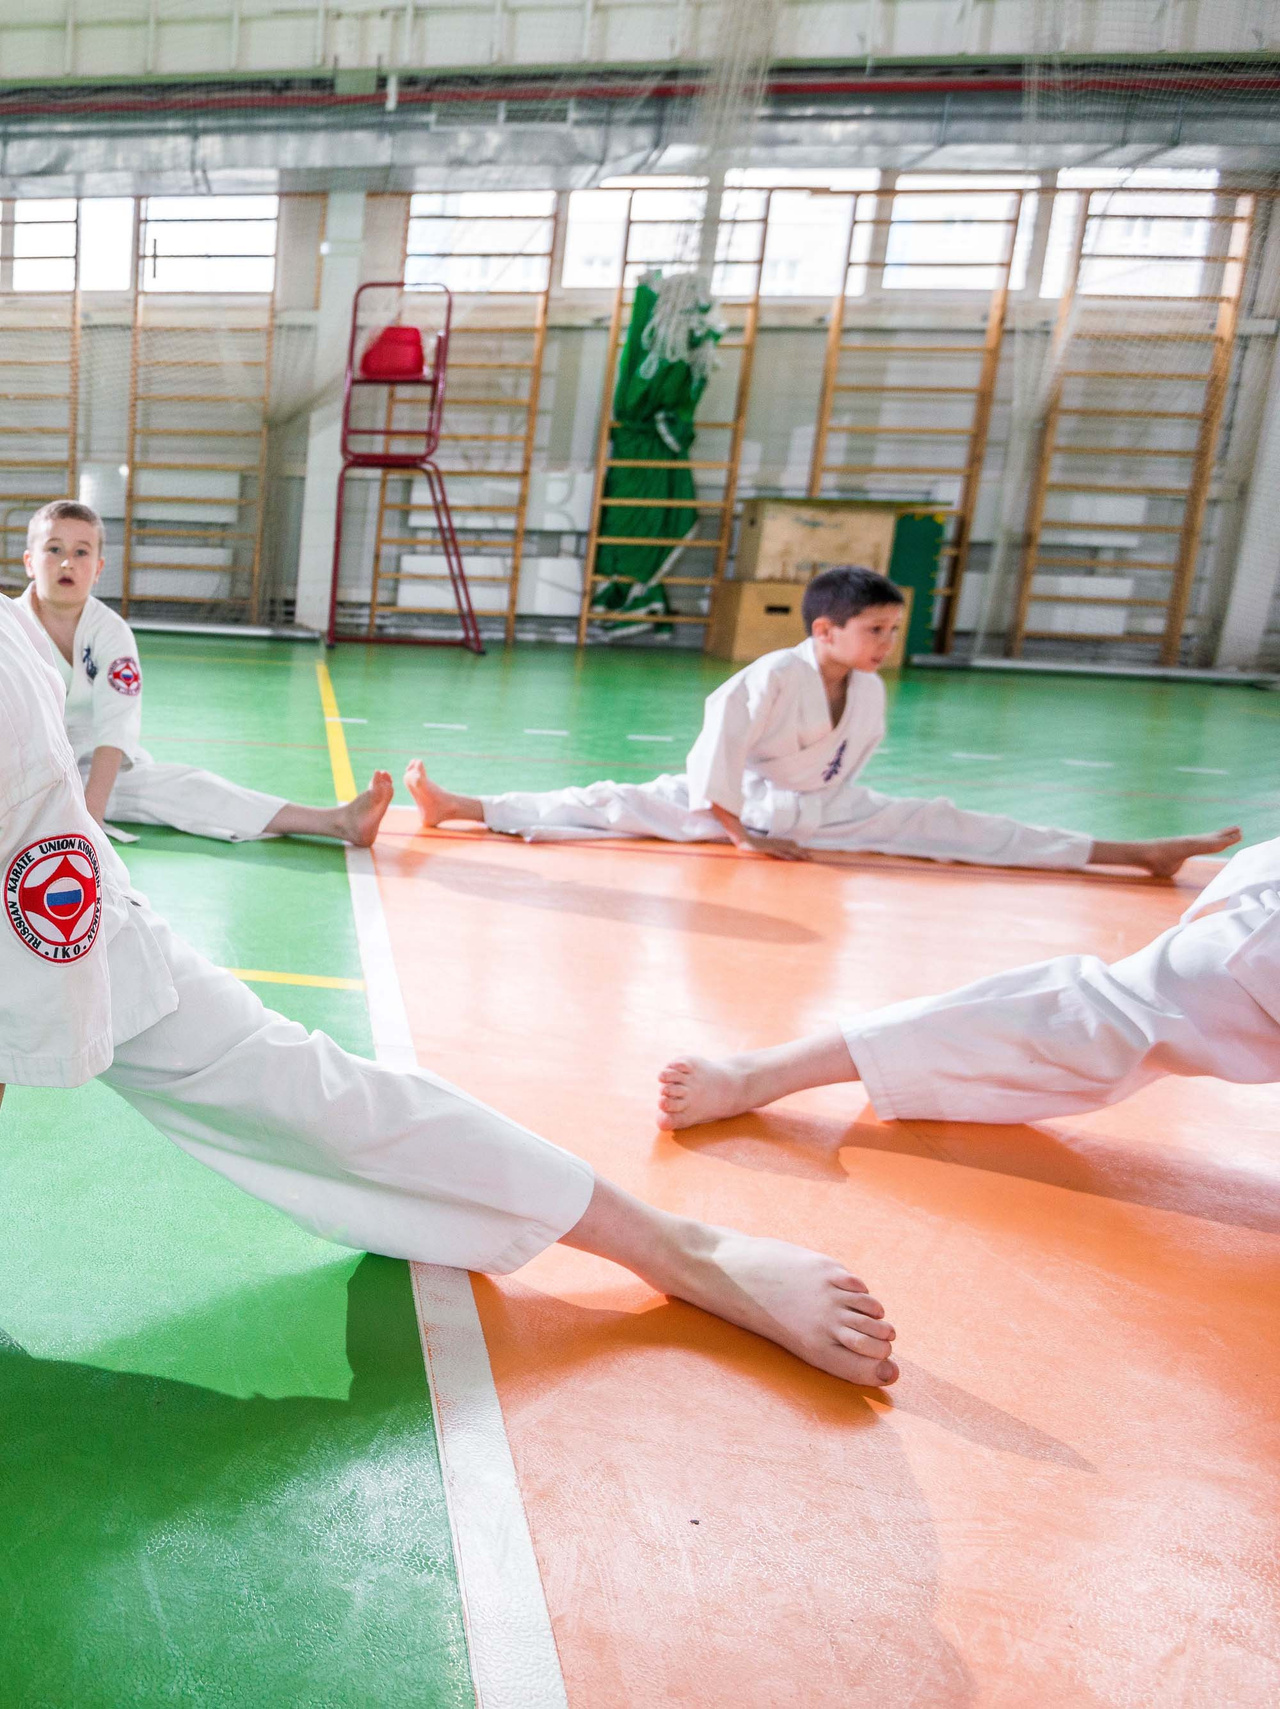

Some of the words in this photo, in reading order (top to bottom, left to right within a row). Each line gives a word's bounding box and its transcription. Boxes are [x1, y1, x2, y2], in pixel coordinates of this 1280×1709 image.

[39, 838, 76, 854] UNION
[8, 852, 35, 893] KARATE
[8, 901, 41, 949] RUSSIAN
